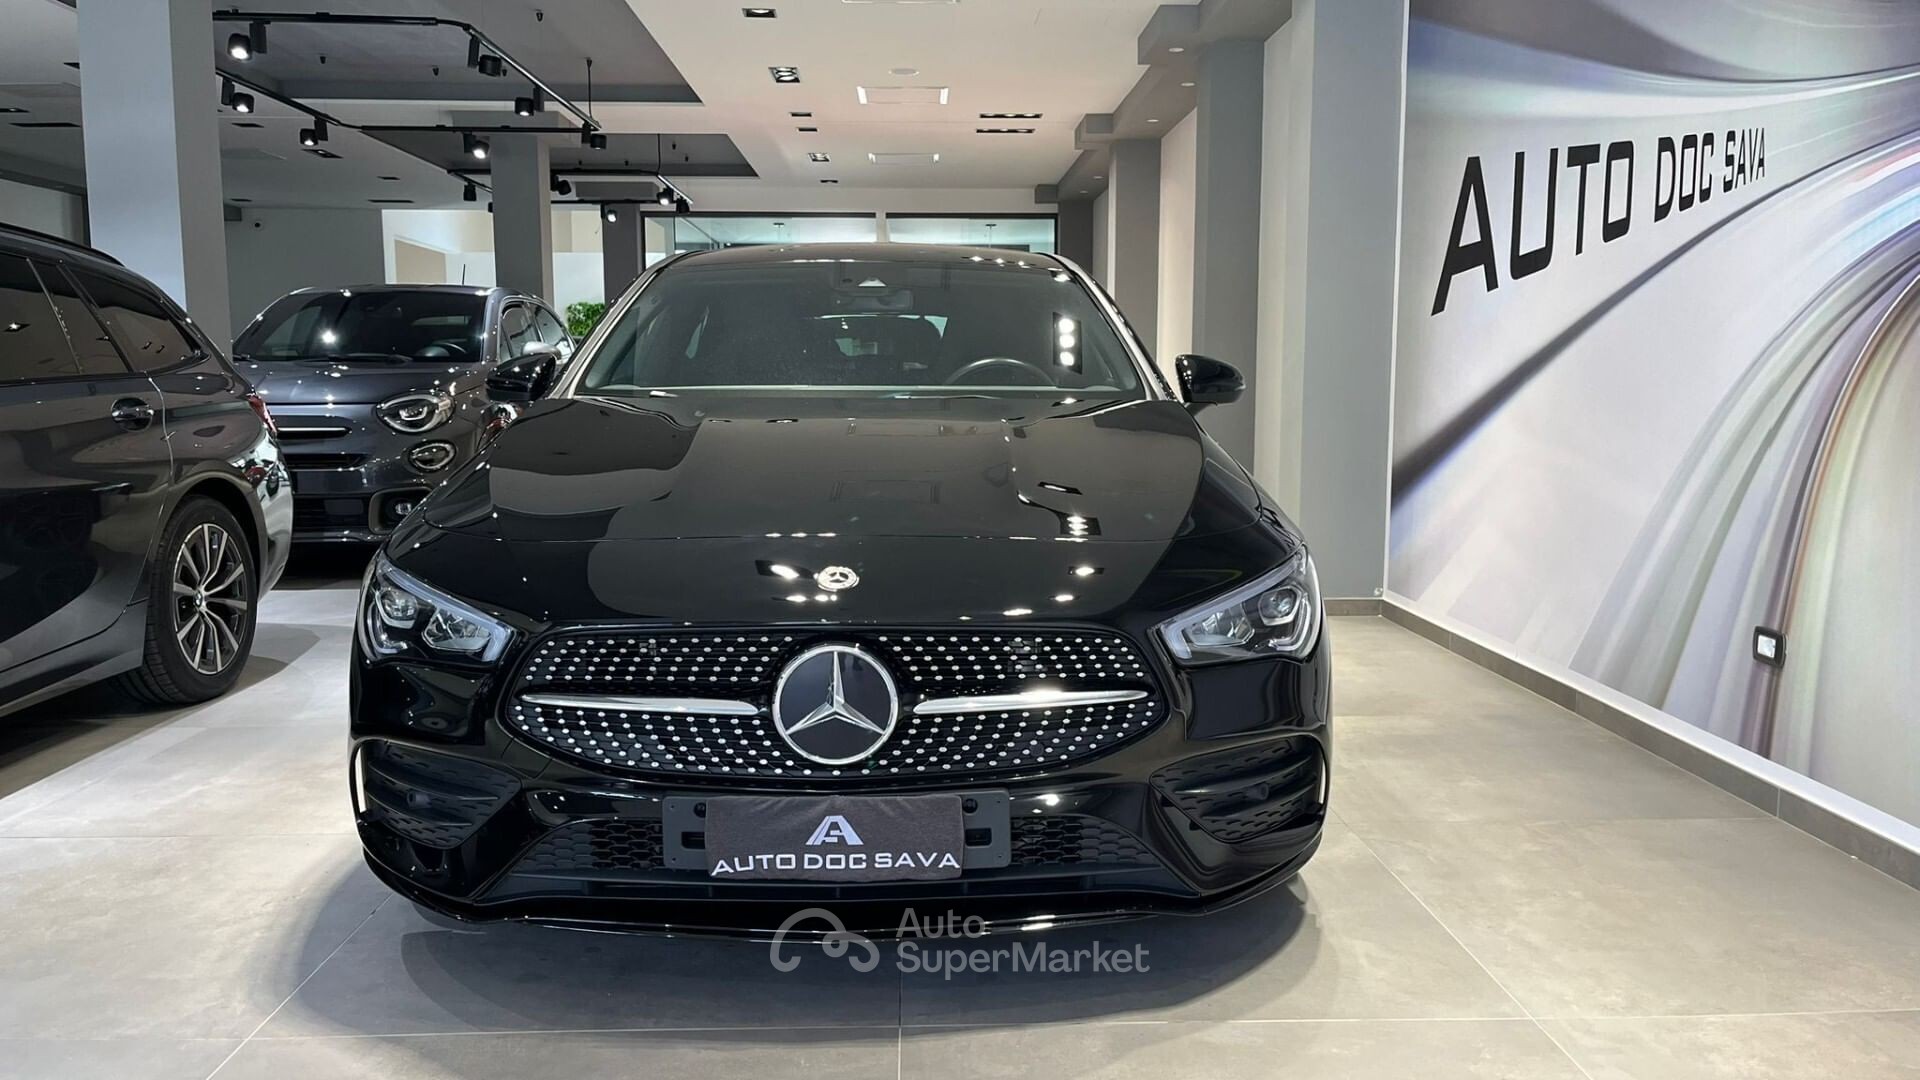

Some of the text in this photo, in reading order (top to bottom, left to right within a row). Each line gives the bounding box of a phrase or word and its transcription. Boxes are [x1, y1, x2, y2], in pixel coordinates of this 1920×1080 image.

[1431, 128, 1766, 316] AUTO DOC SAVA
[710, 852, 961, 876] AUTO DOC SAVA
